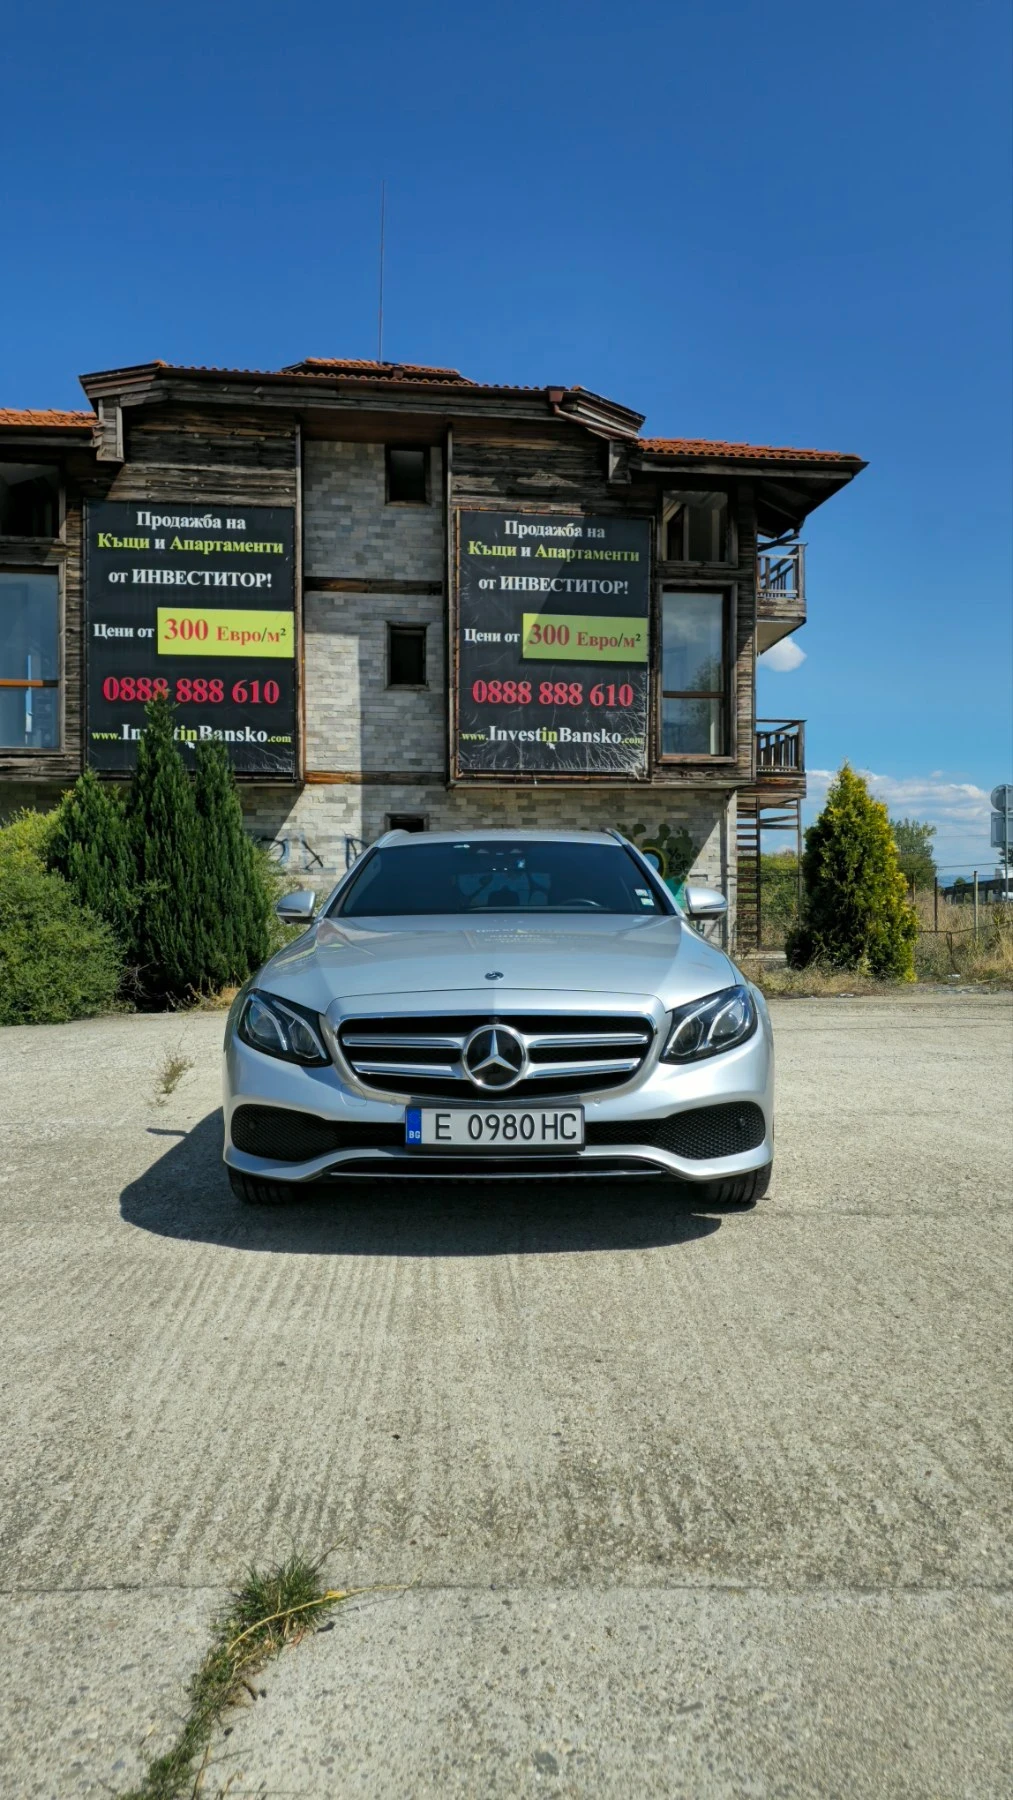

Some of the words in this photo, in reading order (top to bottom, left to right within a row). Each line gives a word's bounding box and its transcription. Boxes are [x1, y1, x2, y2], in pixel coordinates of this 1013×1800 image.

[136, 511, 221, 530] Продажба
[226, 517, 246, 530] на
[504, 520, 582, 538] Продажба
[587, 527, 605, 538] на
[97, 533, 149, 550] Къщи
[154, 539, 165, 549] и
[170, 536, 283, 554] Апартаменти
[468, 541, 516, 557] Къщи
[521, 547, 531, 557] и
[535, 544, 639, 562] Апартаменти
[108, 572, 128, 583] от
[132, 569, 272, 588] ИНВЕСТИТОР!
[478, 578, 496, 589] от
[500, 576, 629, 595] ИНВЕСТИТОР!
[93, 623, 134, 639] Цени
[137, 628, 155, 638] от
[164, 618, 208, 641] 300
[464, 628, 501, 643] Цени
[504, 633, 520, 643] от
[528, 624, 570, 646] 300
[103, 676, 169, 701] 0888
[176, 678, 224, 703] 888
[232, 680, 280, 704] 610
[472, 680, 532, 704] 0888
[539, 682, 583, 706] 888
[590, 683, 634, 707] 610
[91, 724, 292, 743] www.IntinBansko.com
[462, 725, 644, 745] www.InvestinBansko.com
[408, 1130, 421, 1139] BG
[435, 1113, 451, 1140] E
[468, 1113, 535, 1141] 0980
[541, 1113, 577, 1140] HC
